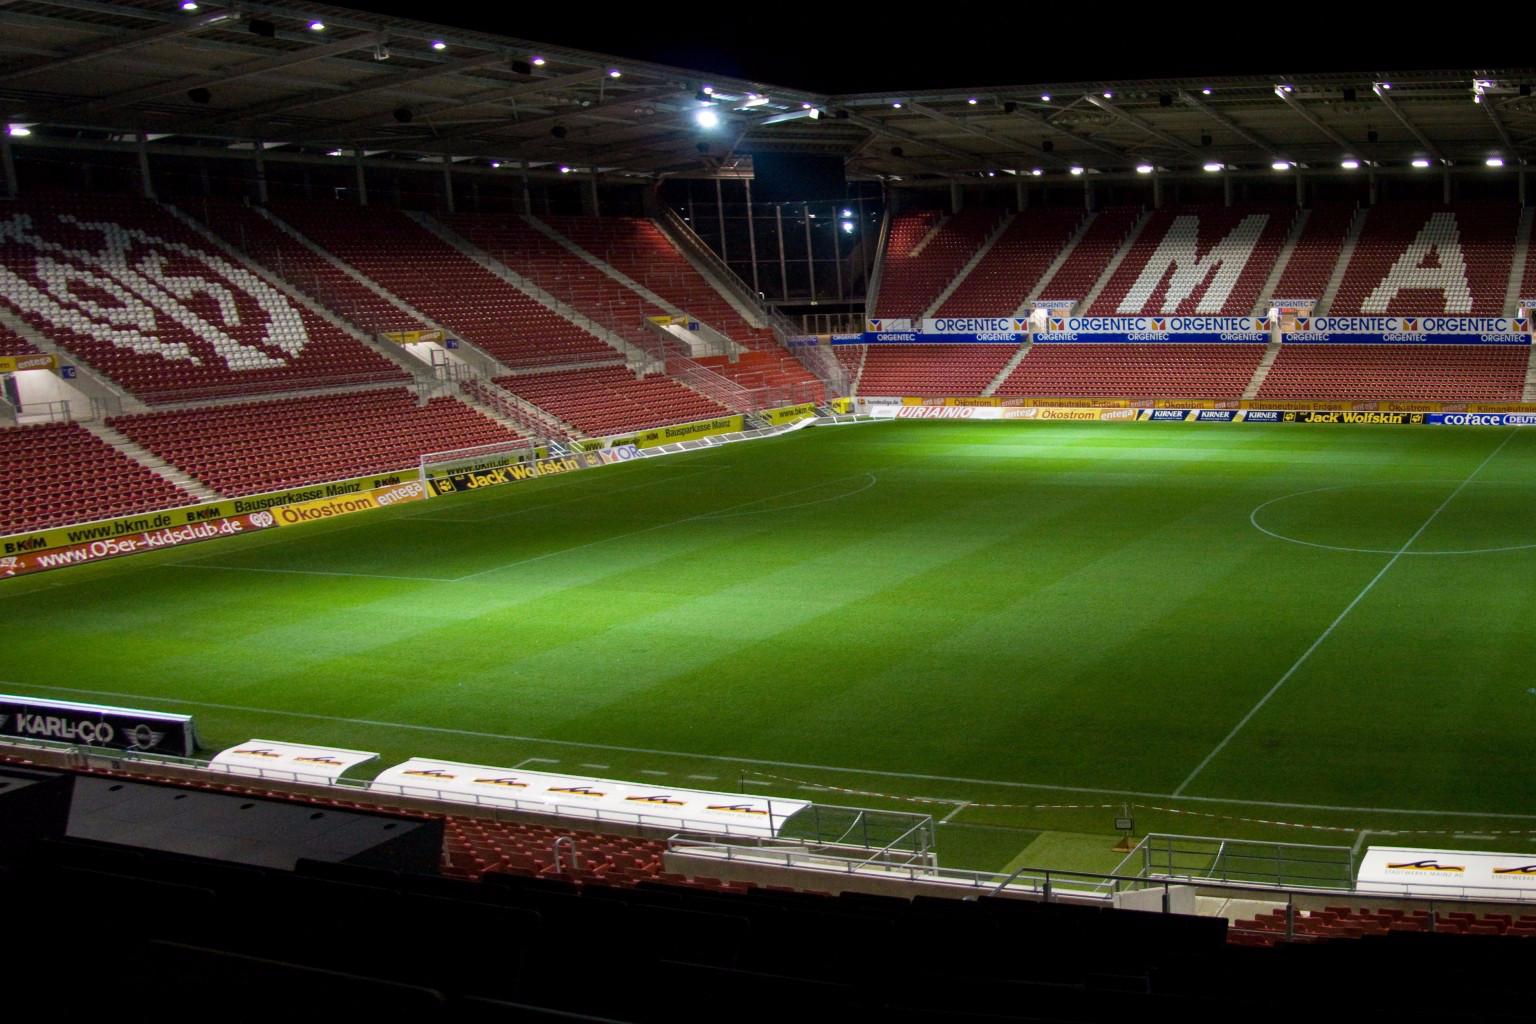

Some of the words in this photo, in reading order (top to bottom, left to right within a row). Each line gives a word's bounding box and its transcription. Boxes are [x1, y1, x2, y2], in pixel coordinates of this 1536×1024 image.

[935, 318, 1008, 331] ORGENTEC
[1069, 318, 1146, 331] ORGENTEC
[1172, 318, 1250, 331] ORGENTEC
[1315, 318, 1397, 331] ORGENTEC
[1423, 318, 1507, 332] ORGENTEC
[1038, 333, 1078, 341] ORGENTEC
[1220, 333, 1263, 341] ORGENTEC
[1286, 333, 1329, 341] ORGENTEC
[1481, 334, 1525, 342] ORGENTEC
[1249, 411, 1277, 419] KIRNER
[1305, 412, 1339, 423] Jack
[1343, 412, 1402, 424] Wolfskin
[1444, 413, 1499, 425] coface
[467, 468, 510, 488] Jack
[234, 488, 323, 513] Bausparkasse
[326, 481, 361, 497] Mainz
[282, 496, 373, 523] Ökostrom
[377, 481, 422, 507] entega
[68, 514, 171, 542] www.bkm.de
